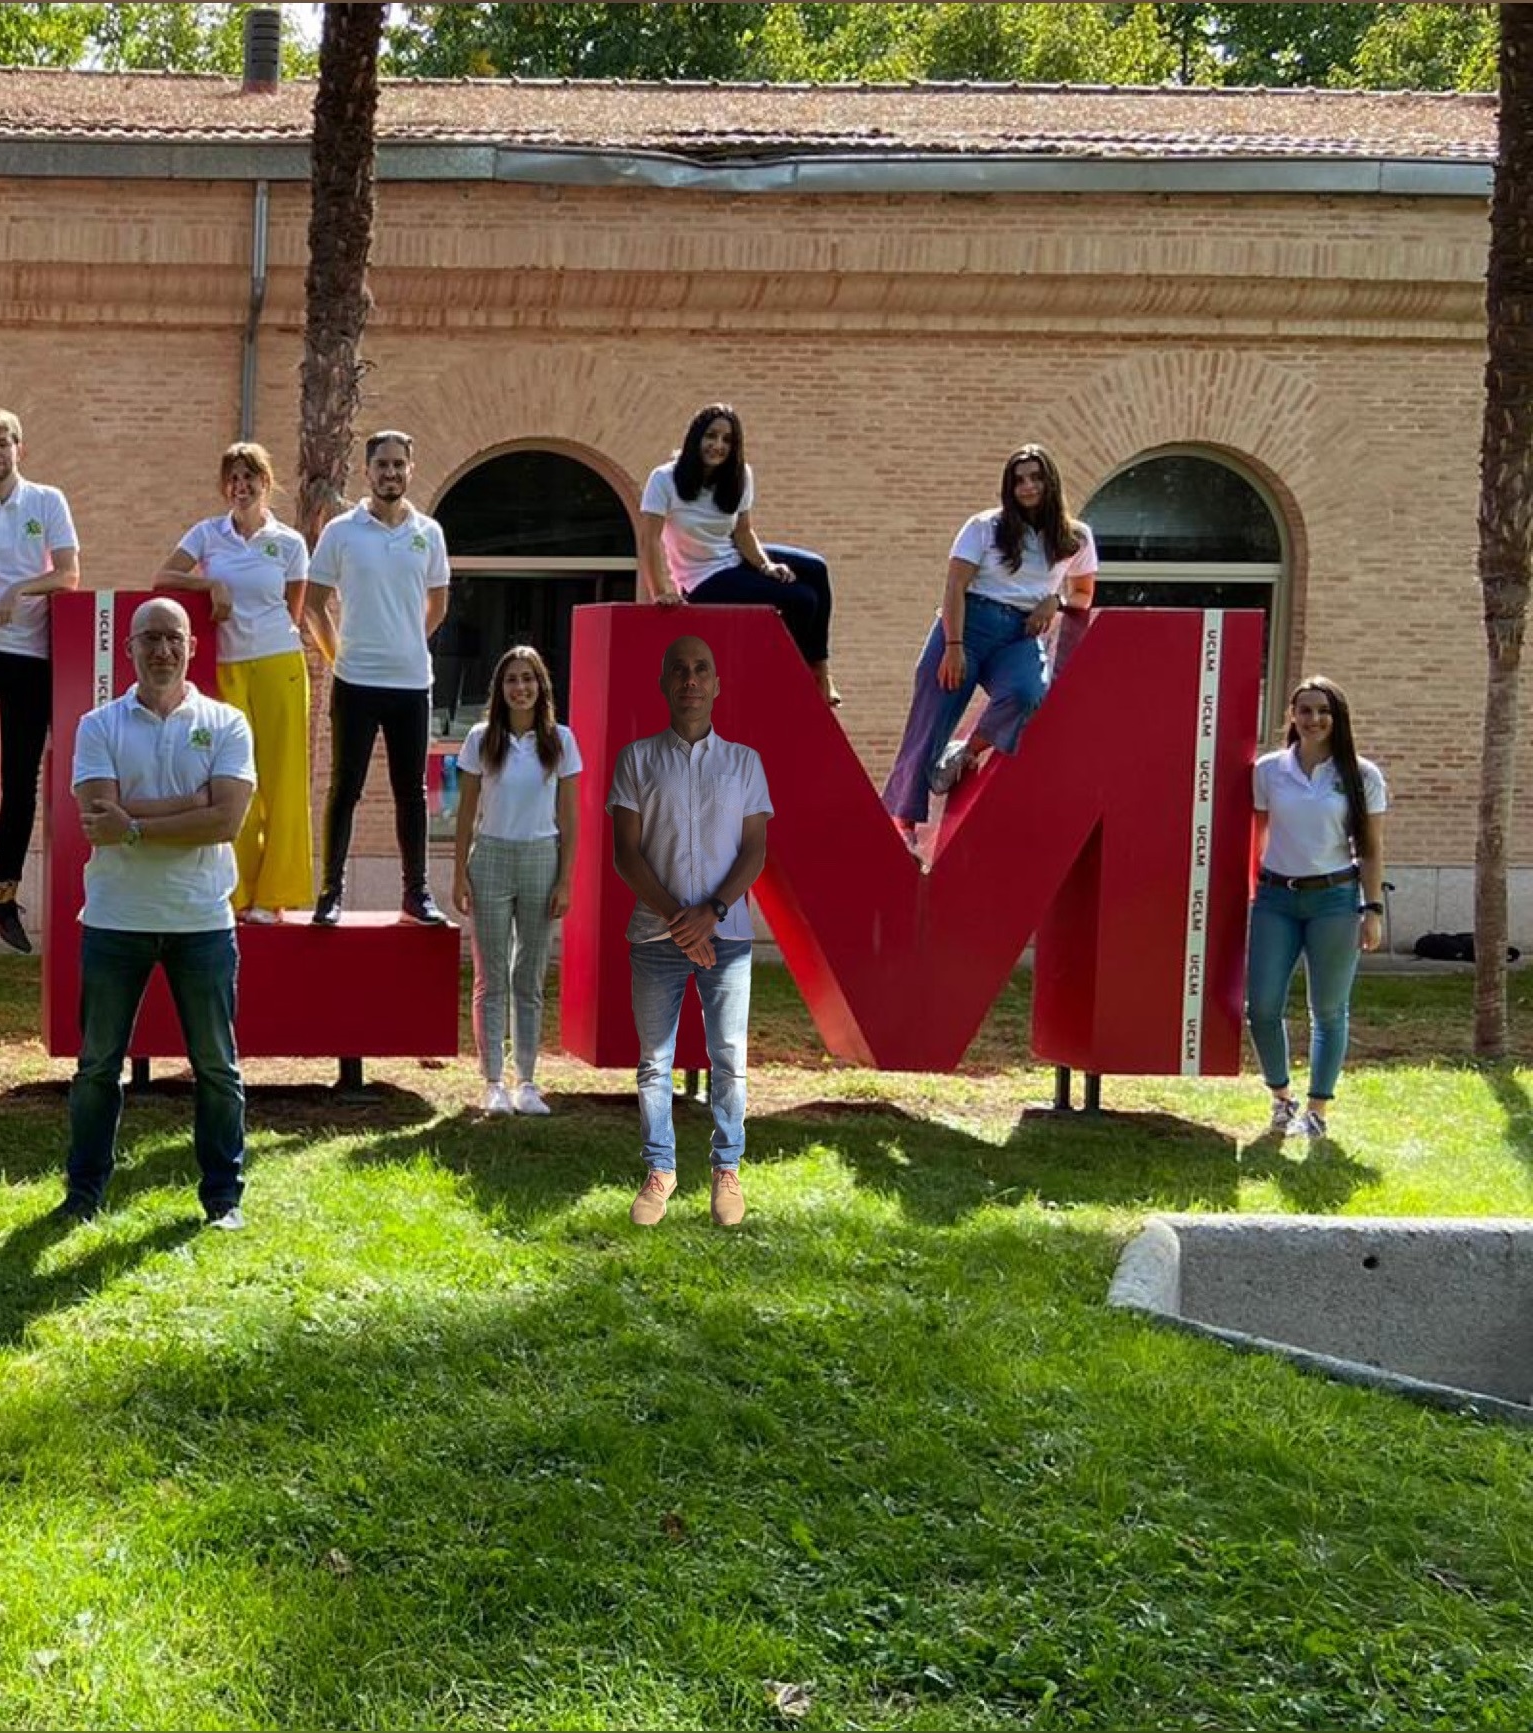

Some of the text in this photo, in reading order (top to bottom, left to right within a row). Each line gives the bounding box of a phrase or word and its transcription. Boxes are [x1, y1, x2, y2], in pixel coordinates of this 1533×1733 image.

[100, 609, 109, 651] UCLM
[1206, 630, 1217, 672] UCLM
[99, 675, 108, 704] UCL
[1203, 695, 1213, 737] UCLM
[1199, 760, 1210, 802] UCLM
[1196, 824, 1207, 867] UCLM
[1192, 890, 1203, 931] UCLM
[1188, 954, 1200, 996] UCLM
[1186, 1018, 1197, 1060] UCLM
